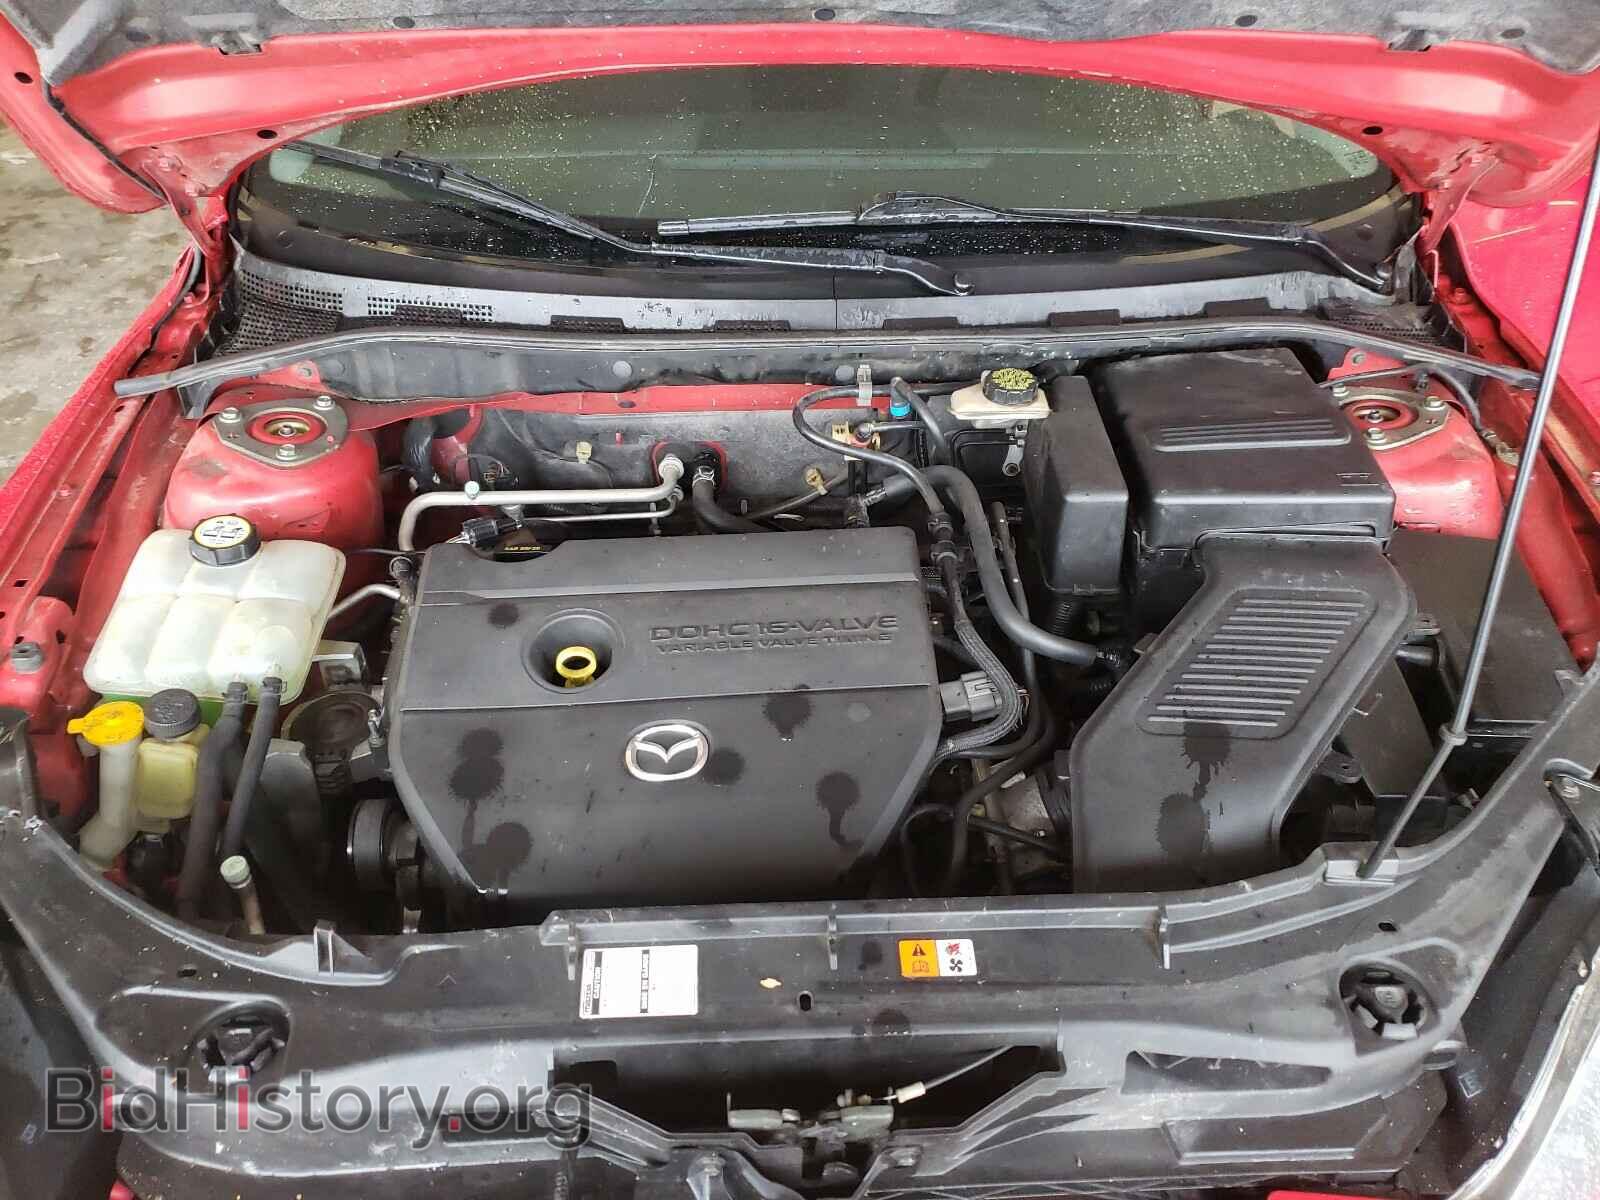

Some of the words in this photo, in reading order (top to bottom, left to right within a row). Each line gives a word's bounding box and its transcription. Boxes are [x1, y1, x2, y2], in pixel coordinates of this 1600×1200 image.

[650, 621, 750, 642] DOHC
[656, 640, 753, 655] VARIABLE
[759, 637, 817, 650] VALVE
